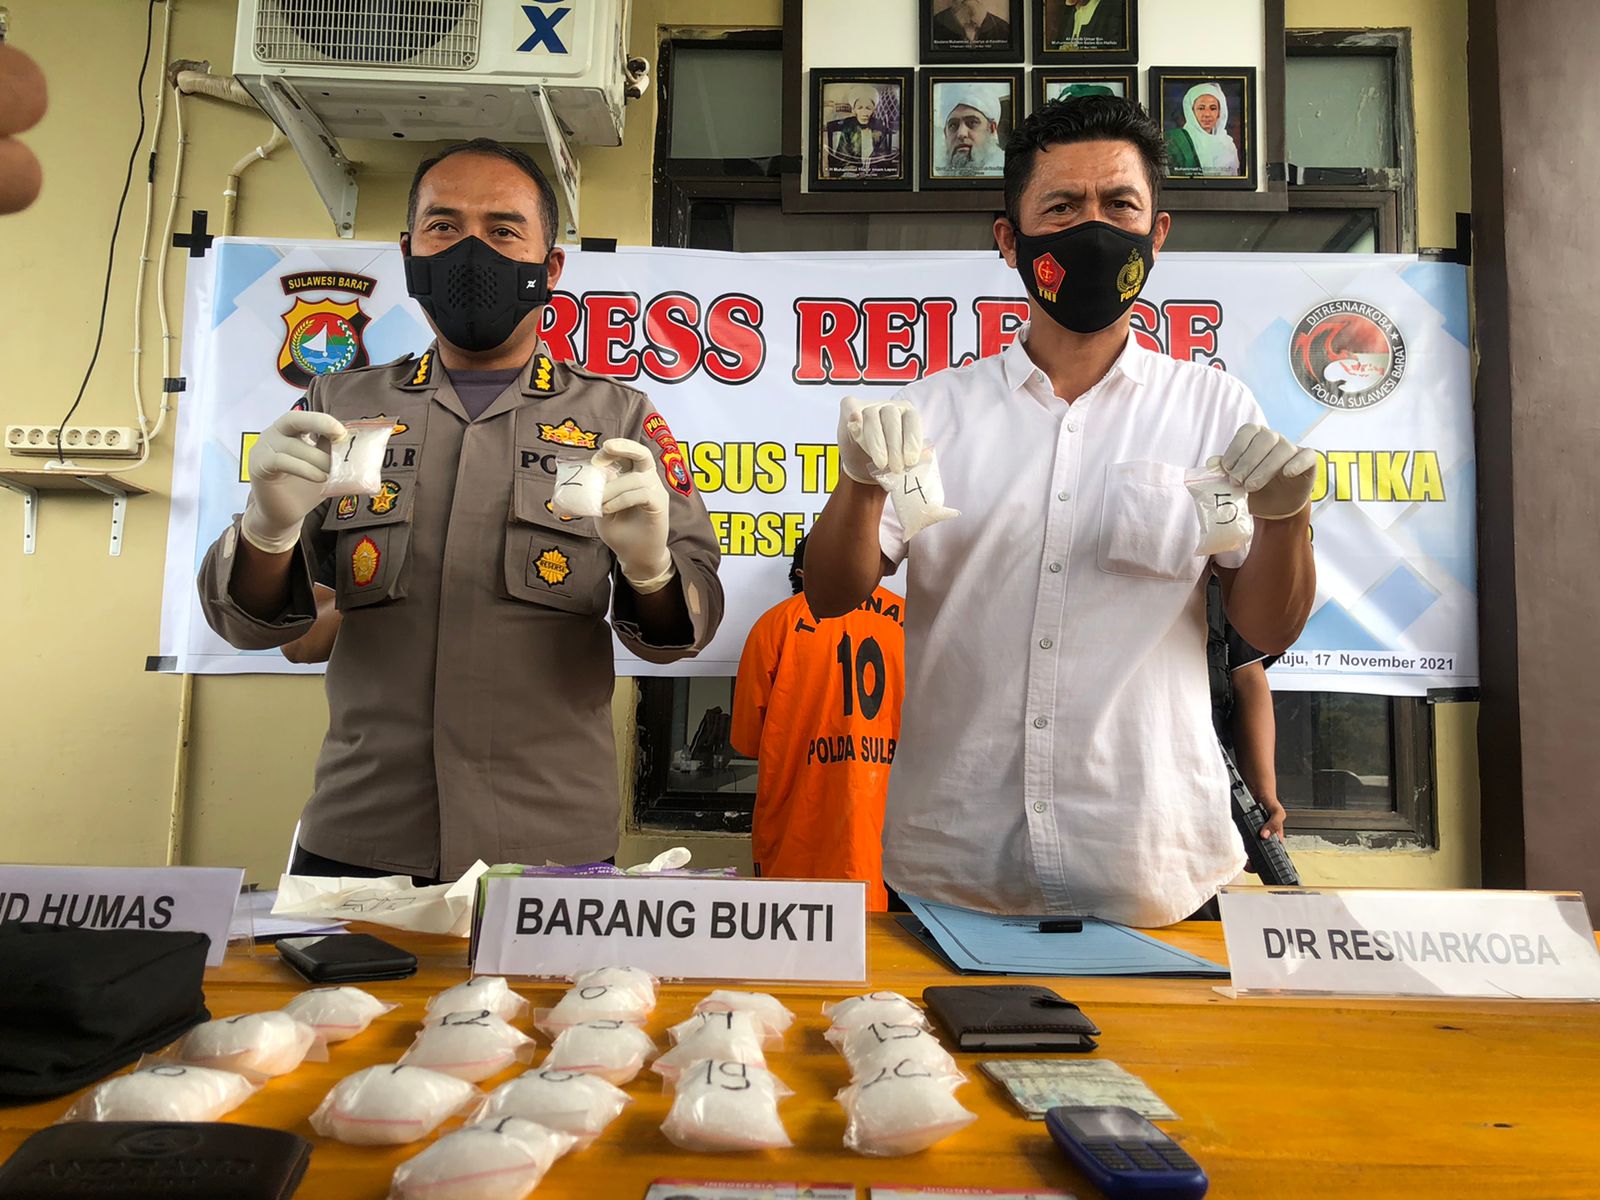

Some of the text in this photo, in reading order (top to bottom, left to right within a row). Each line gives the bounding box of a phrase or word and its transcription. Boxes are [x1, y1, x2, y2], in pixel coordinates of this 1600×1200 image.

[516, 0, 571, 55] X
[288, 276, 369, 291] SULAWESI BARAT
[1038, 289, 1057, 303] TNI
[1306, 302, 1393, 333] DITRESNARKOBA
[537, 290, 1226, 386] RESS RELESE
[1311, 345, 1405, 408] POLDA SULAWESI BARAT
[560, 464, 583, 487] 2
[903, 474, 927, 504] 4
[1214, 493, 1238, 524] 5
[837, 631, 886, 720] 10
[1314, 653, 1331, 666] 17
[1339, 653, 1416, 669] November
[1419, 657, 1454, 670] 2021
[807, 735, 897, 764] POLDA SULB
[39, 893, 175, 930] HUMAS
[515, 897, 834, 942] BARANG BUKTI
[1262, 927, 1561, 966] DIR RESNARKOBA
[706, 1059, 751, 1091] 19
[704, 1181, 775, 1190] INDONESIA
